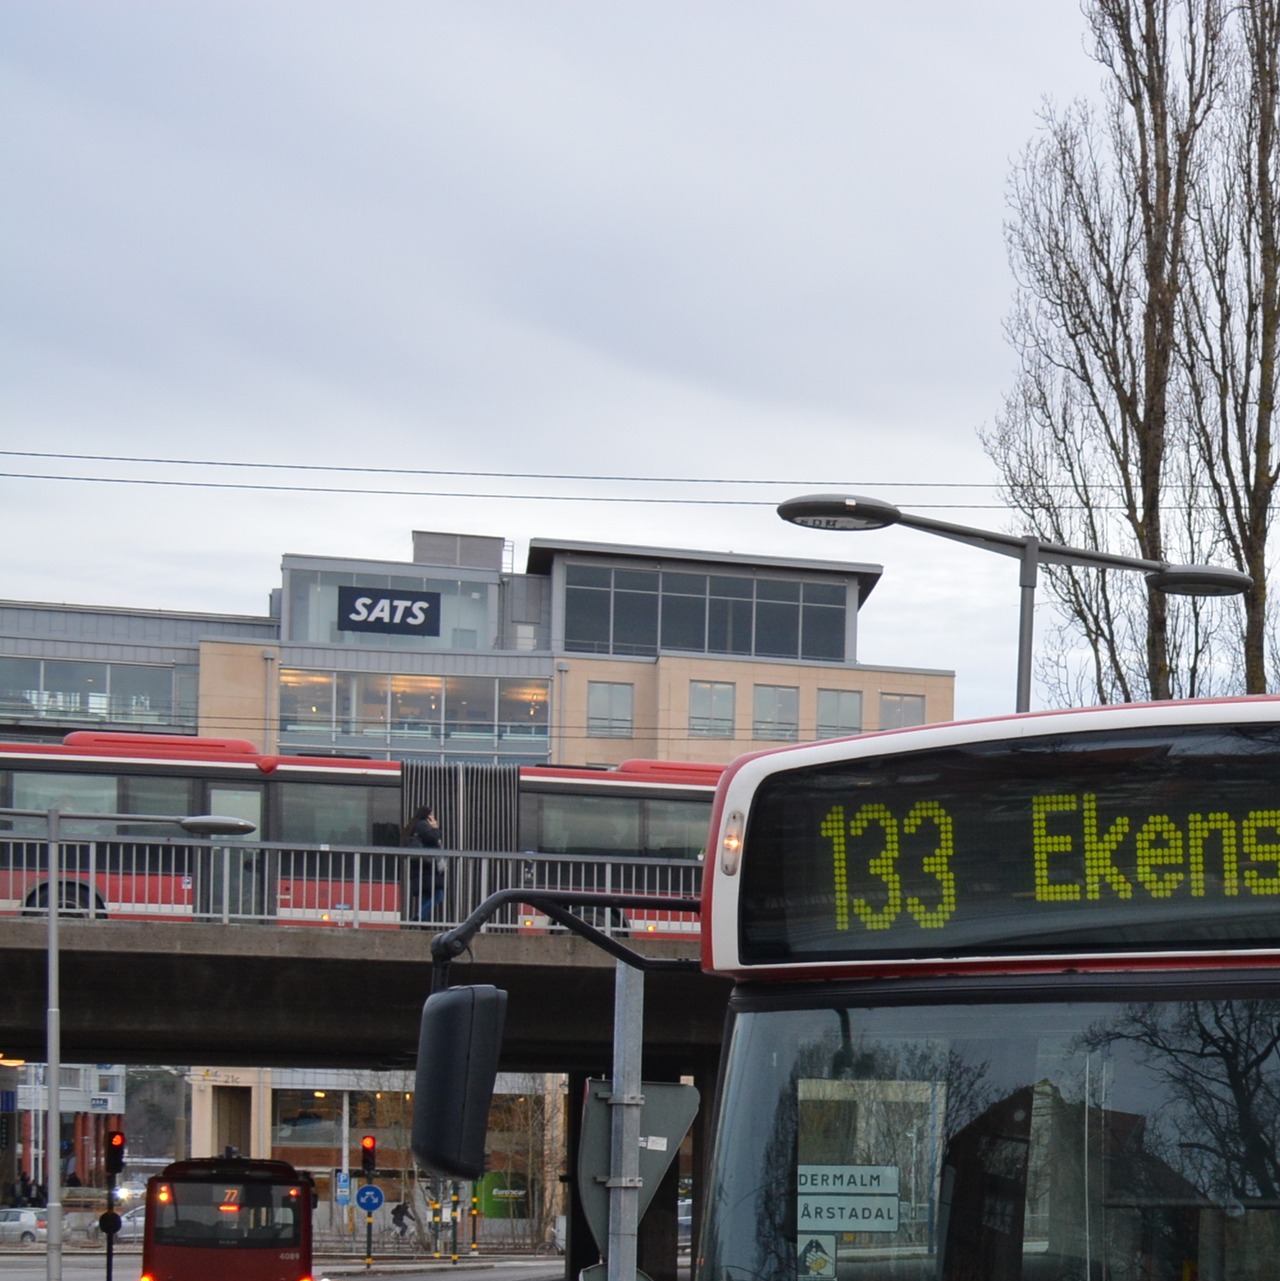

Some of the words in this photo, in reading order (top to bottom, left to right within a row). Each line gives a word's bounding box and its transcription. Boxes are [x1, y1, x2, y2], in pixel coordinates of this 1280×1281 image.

[349, 597, 430, 625] SATS
[821, 801, 956, 931] 133
[799, 1174, 881, 1187] DERMALM
[224, 1189, 239, 1201] 77
[801, 1203, 893, 1220] ÅRSTADAL
